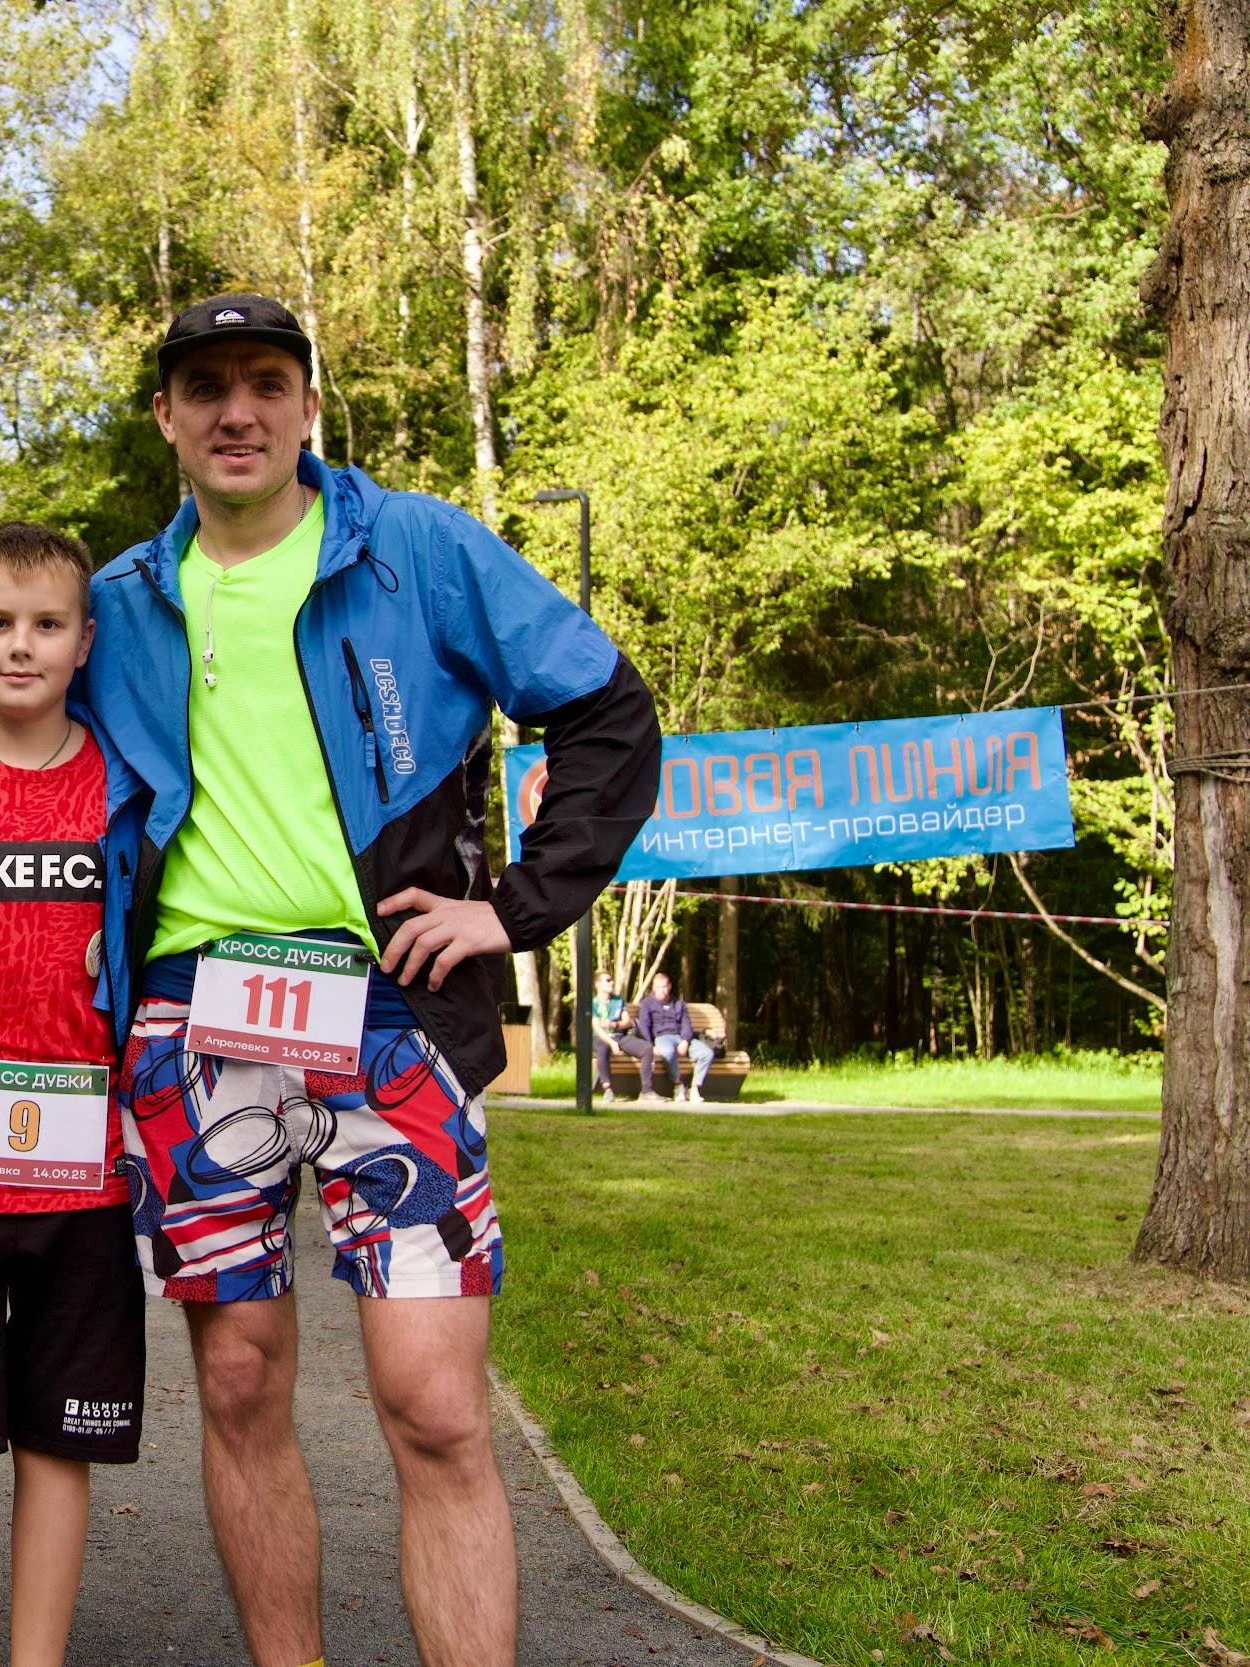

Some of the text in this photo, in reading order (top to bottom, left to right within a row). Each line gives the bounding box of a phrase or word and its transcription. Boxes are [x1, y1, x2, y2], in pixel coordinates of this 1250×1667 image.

[652, 731, 1041, 820] ОВАЯ ЛИНИЯ
[643, 803, 1026, 854] интернет-провайдер
[41, 854, 102, 889] F.C.
[218, 939, 352, 969] КРОСС ДУБКИ
[243, 973, 312, 1032] 111
[204, 1035, 341, 1064] Апрелевка 14.09.25
[31, 1073, 93, 1090] ДУБКИ
[7, 1099, 41, 1152] 9
[32, 1167, 87, 1180] 14.09.25
[82, 1409, 119, 1418] MOOD
[83, 1401, 133, 1411] SUMMER
[102, 1419, 112, 1428] ARE
